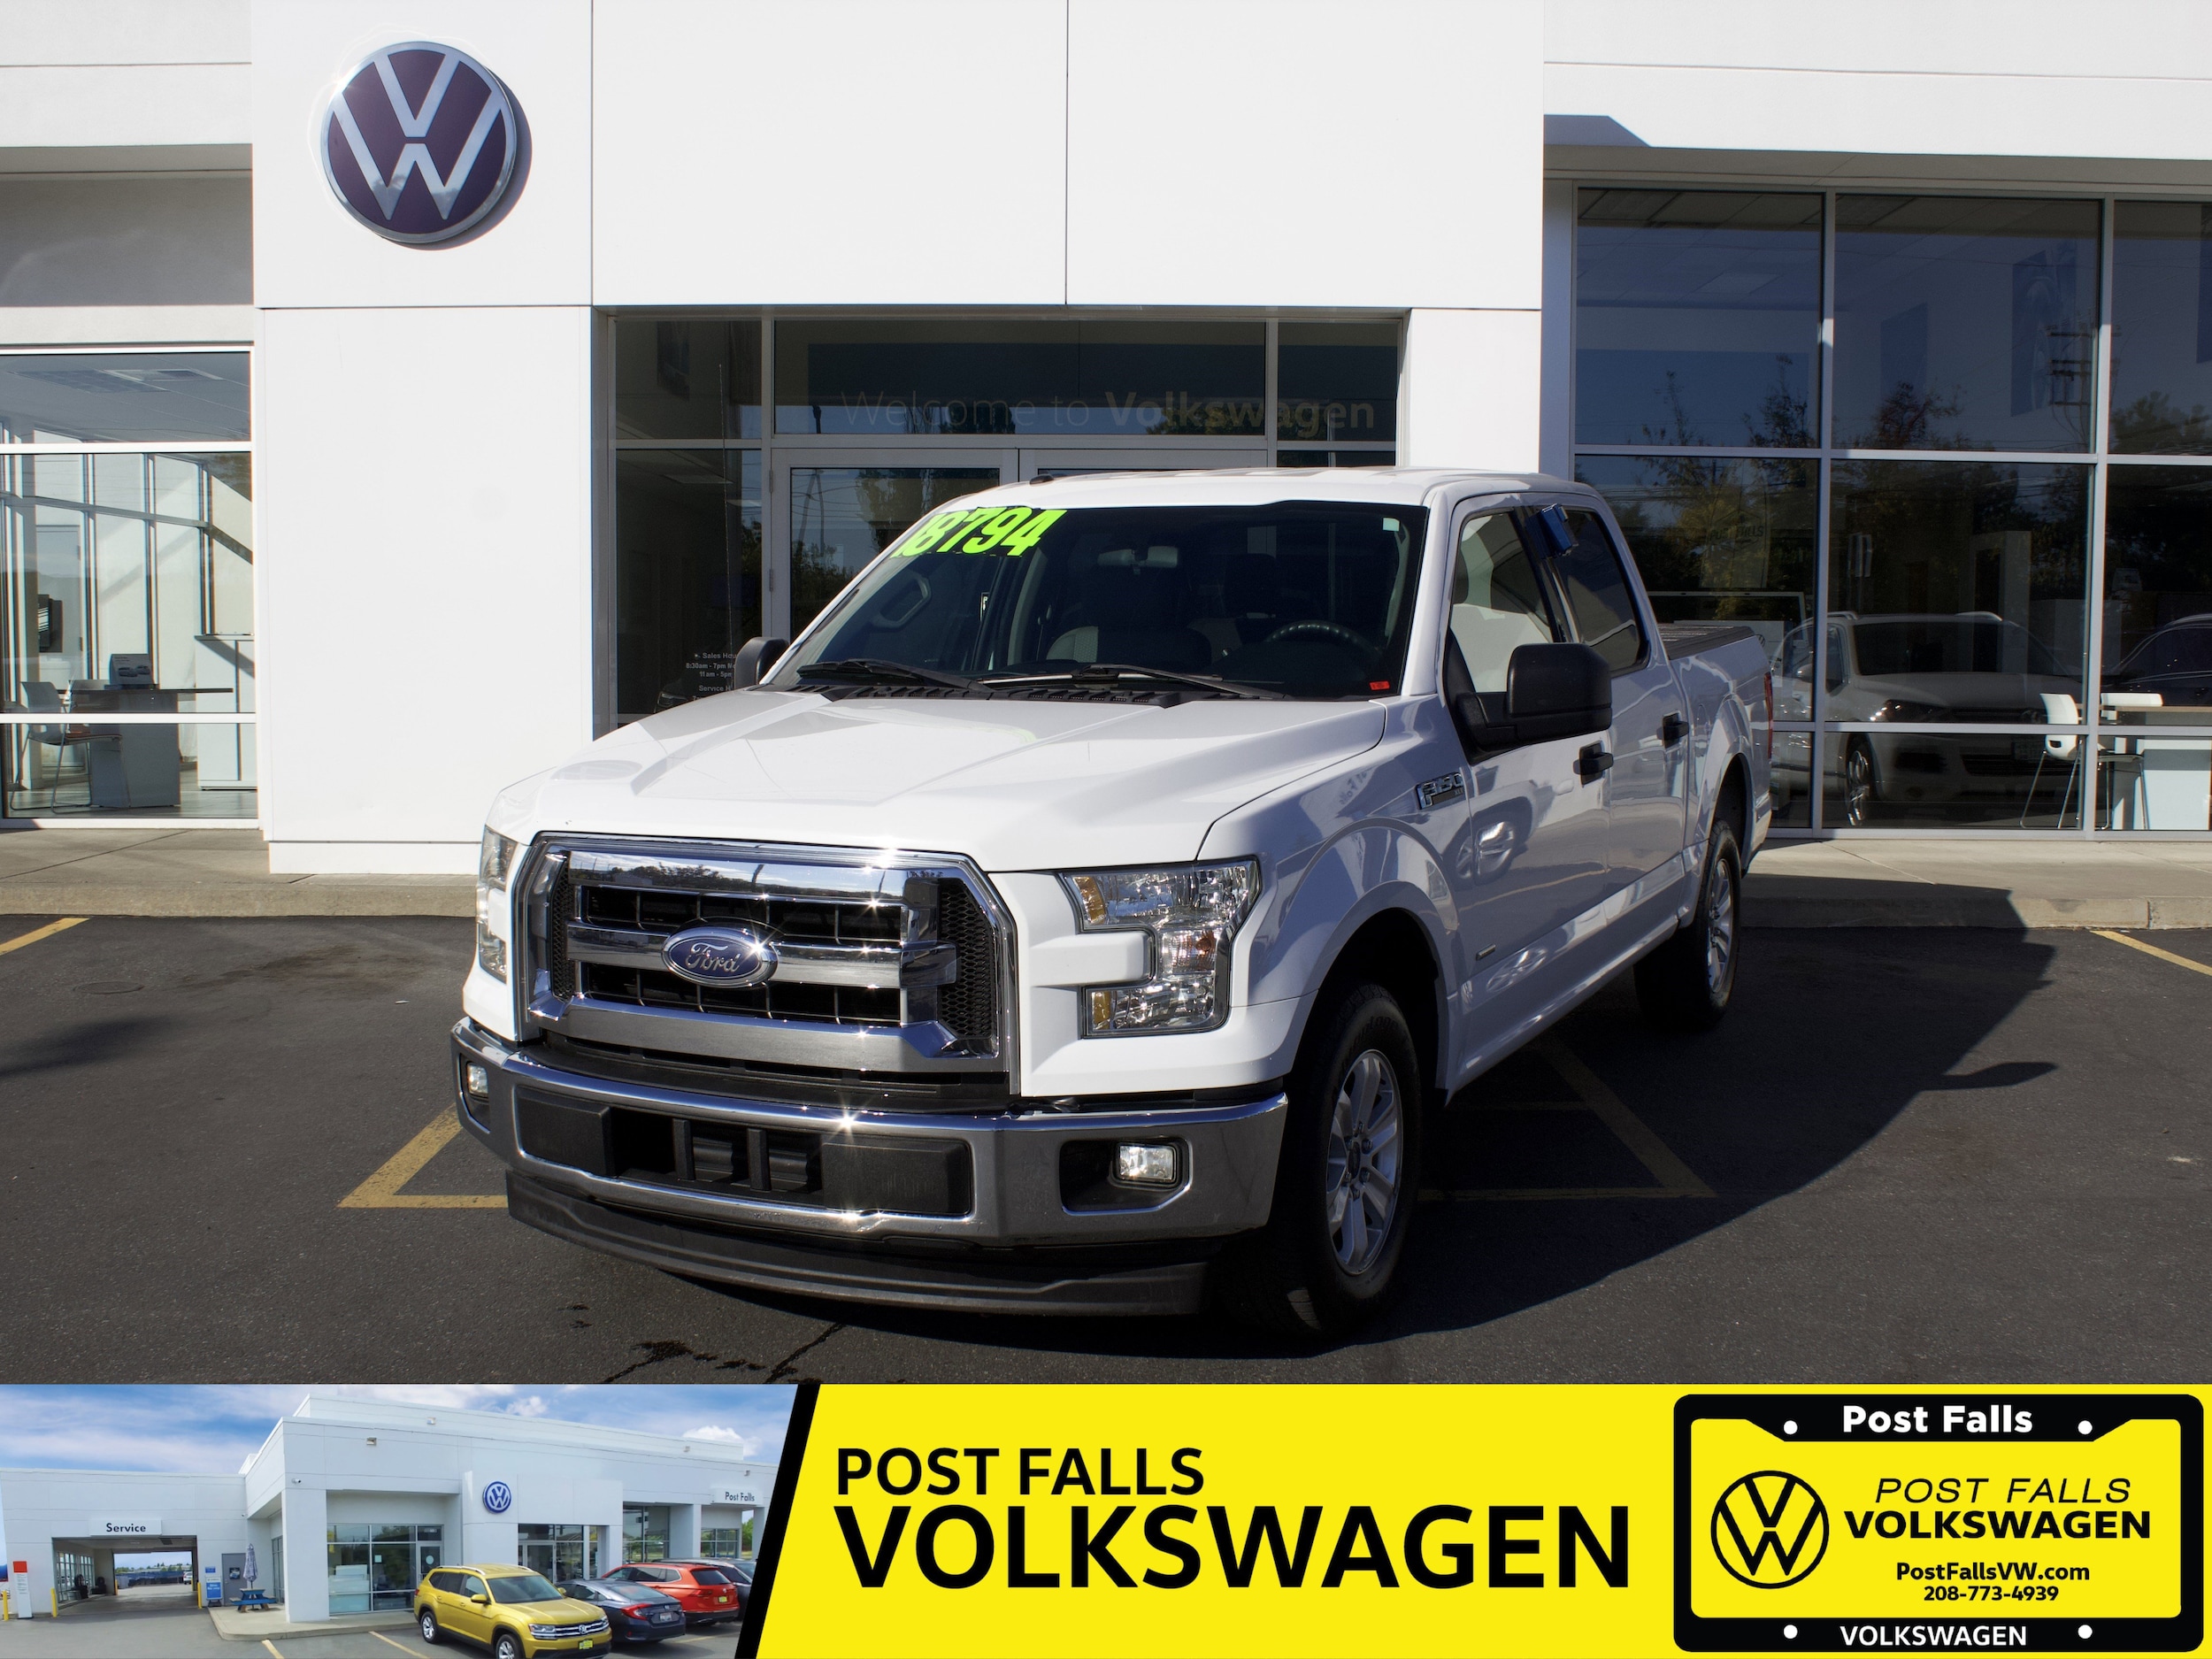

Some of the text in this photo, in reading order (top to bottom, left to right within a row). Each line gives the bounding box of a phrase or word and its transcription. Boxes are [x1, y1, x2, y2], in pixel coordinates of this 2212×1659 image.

[841, 390, 1374, 438] Welcome to Volkswagen
[685, 941, 741, 972] Ford
